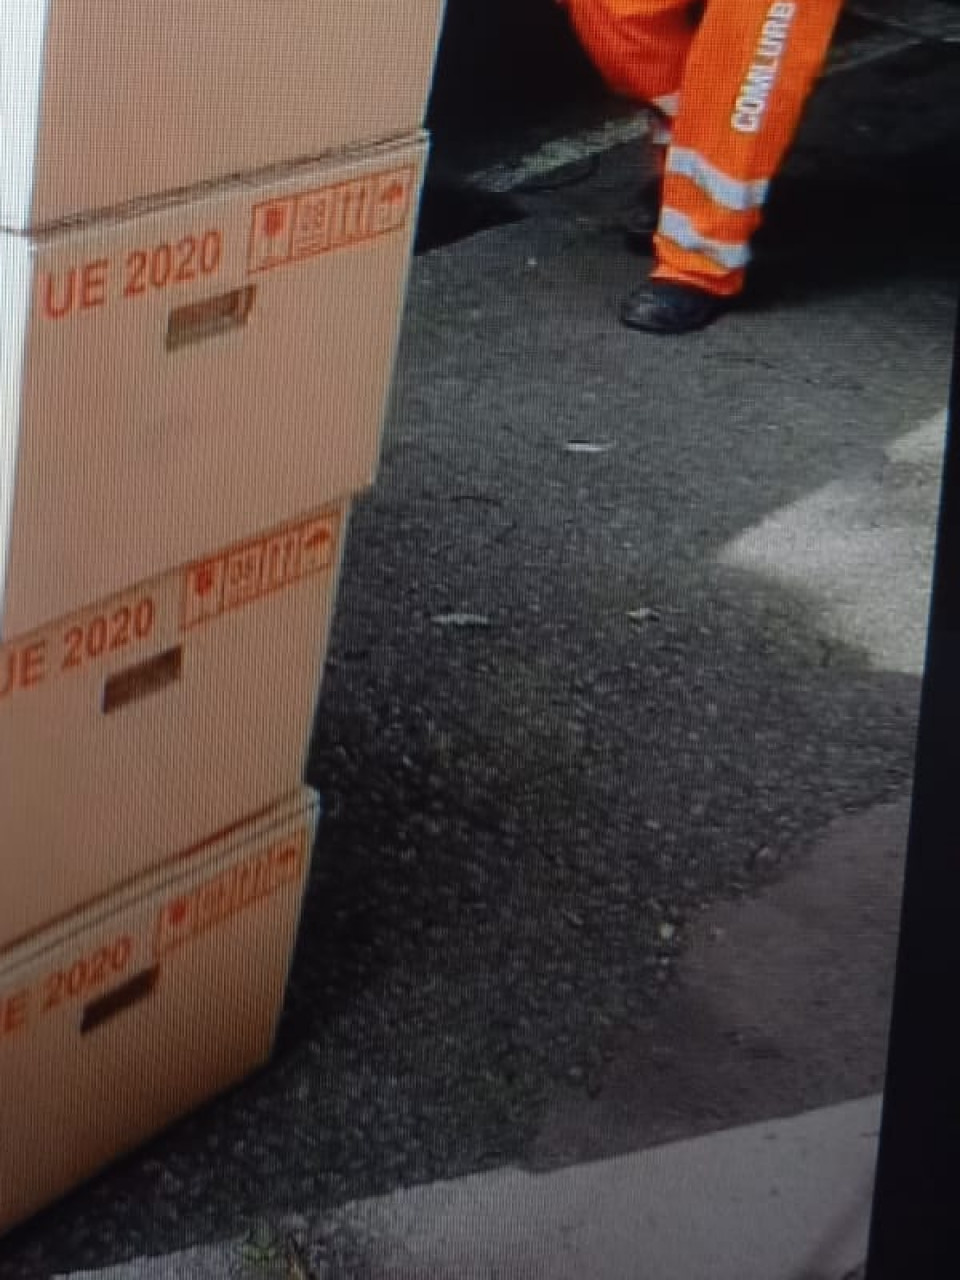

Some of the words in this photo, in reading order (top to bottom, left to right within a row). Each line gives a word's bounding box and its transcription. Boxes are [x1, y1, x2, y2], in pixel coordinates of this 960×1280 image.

[730, 0, 797, 133] COMLURB
[42, 258, 108, 320] UE
[123, 230, 223, 299] 2020
[62, 598, 155, 672] 2020
[42, 936, 134, 1011] 2020
